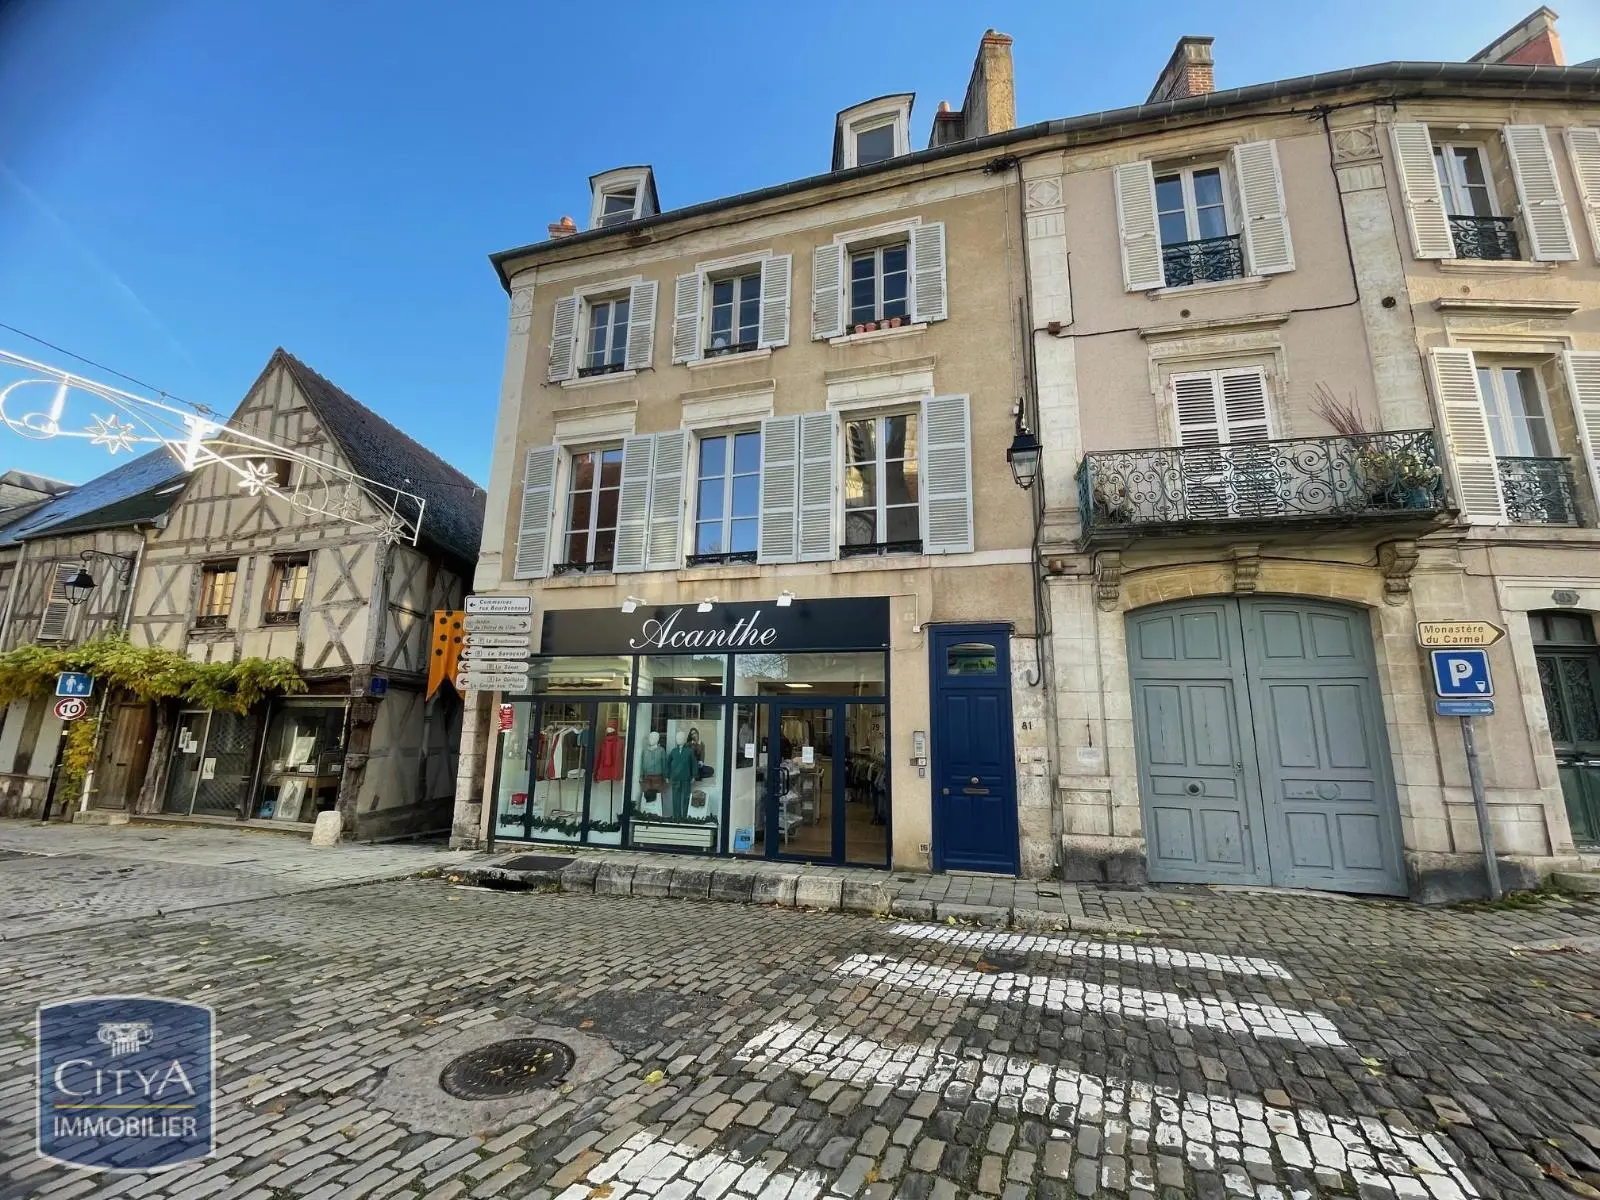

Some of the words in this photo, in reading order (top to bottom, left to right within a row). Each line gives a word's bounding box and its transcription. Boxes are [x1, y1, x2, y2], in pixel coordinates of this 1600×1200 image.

[629, 608, 777, 649] Acanthe
[1423, 624, 1484, 634] Monastère
[1426, 635, 1439, 643] du
[1443, 635, 1485, 643] Carmel
[1447, 659, 1473, 687] P
[62, 704, 79, 714] 10
[1021, 721, 1032, 730] 81
